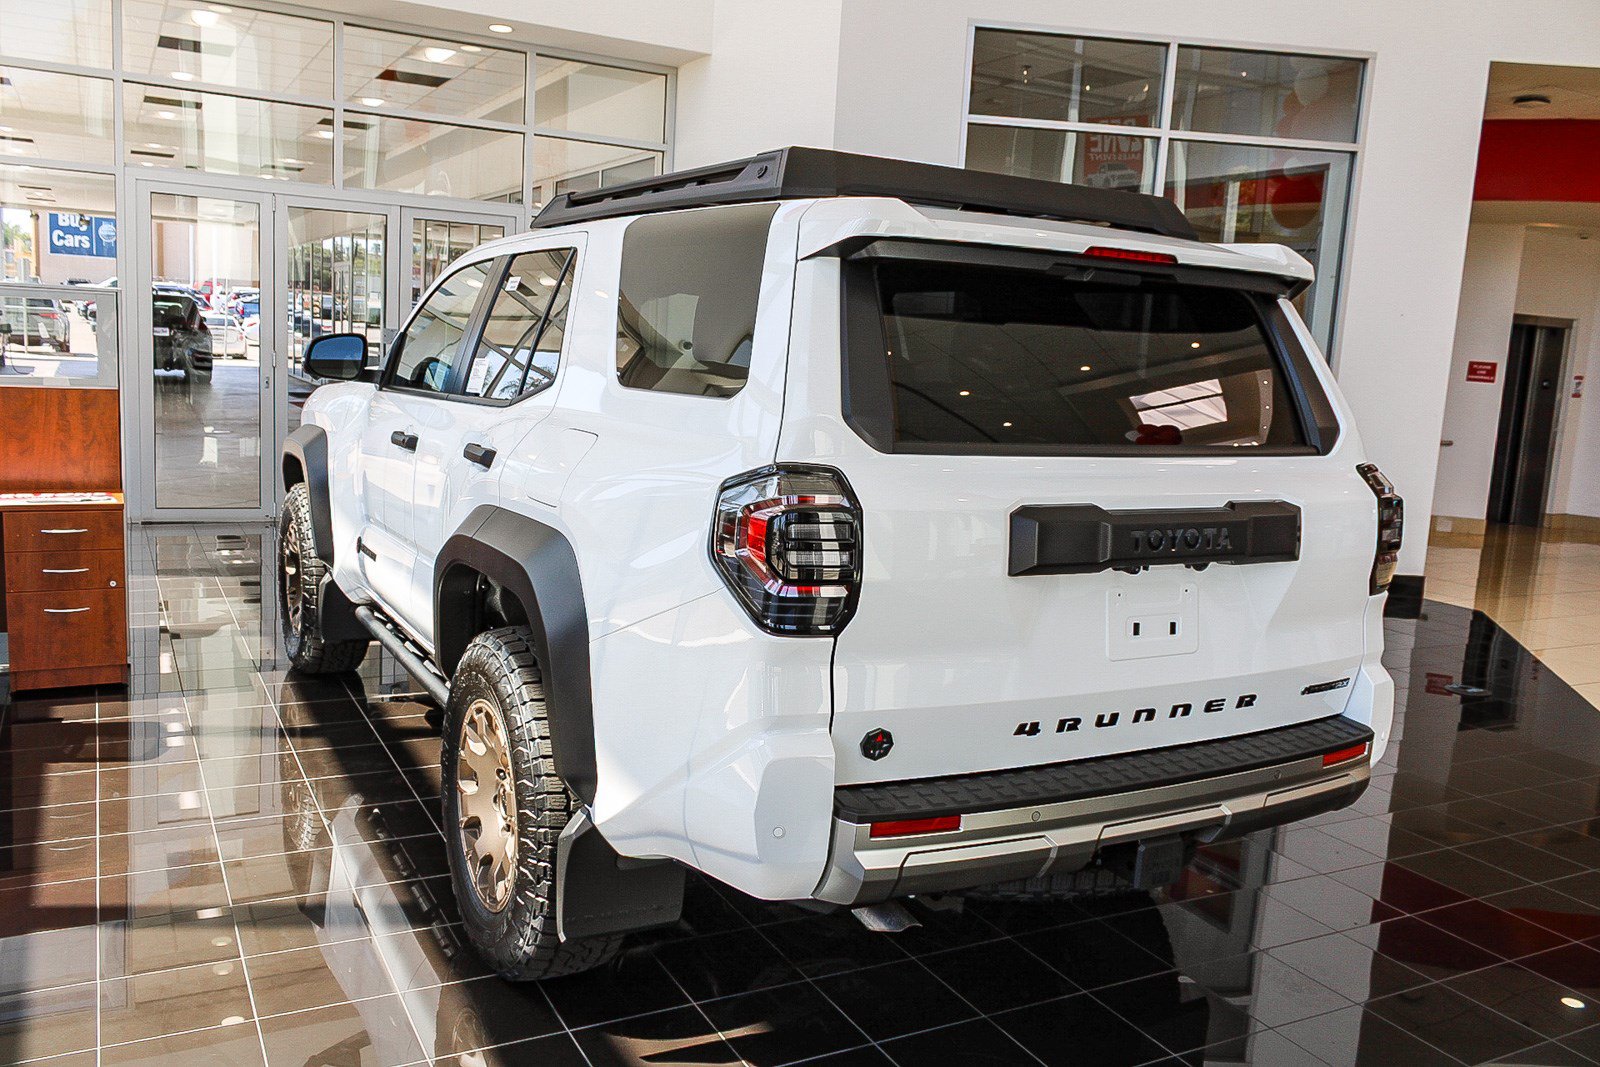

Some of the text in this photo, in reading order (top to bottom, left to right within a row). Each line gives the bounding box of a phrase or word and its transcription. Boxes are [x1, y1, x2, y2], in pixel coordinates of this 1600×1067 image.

[52, 229, 90, 248] Cars
[1130, 527, 1232, 553] TOYOTA
[1013, 694, 1257, 736] 4RUNNER
